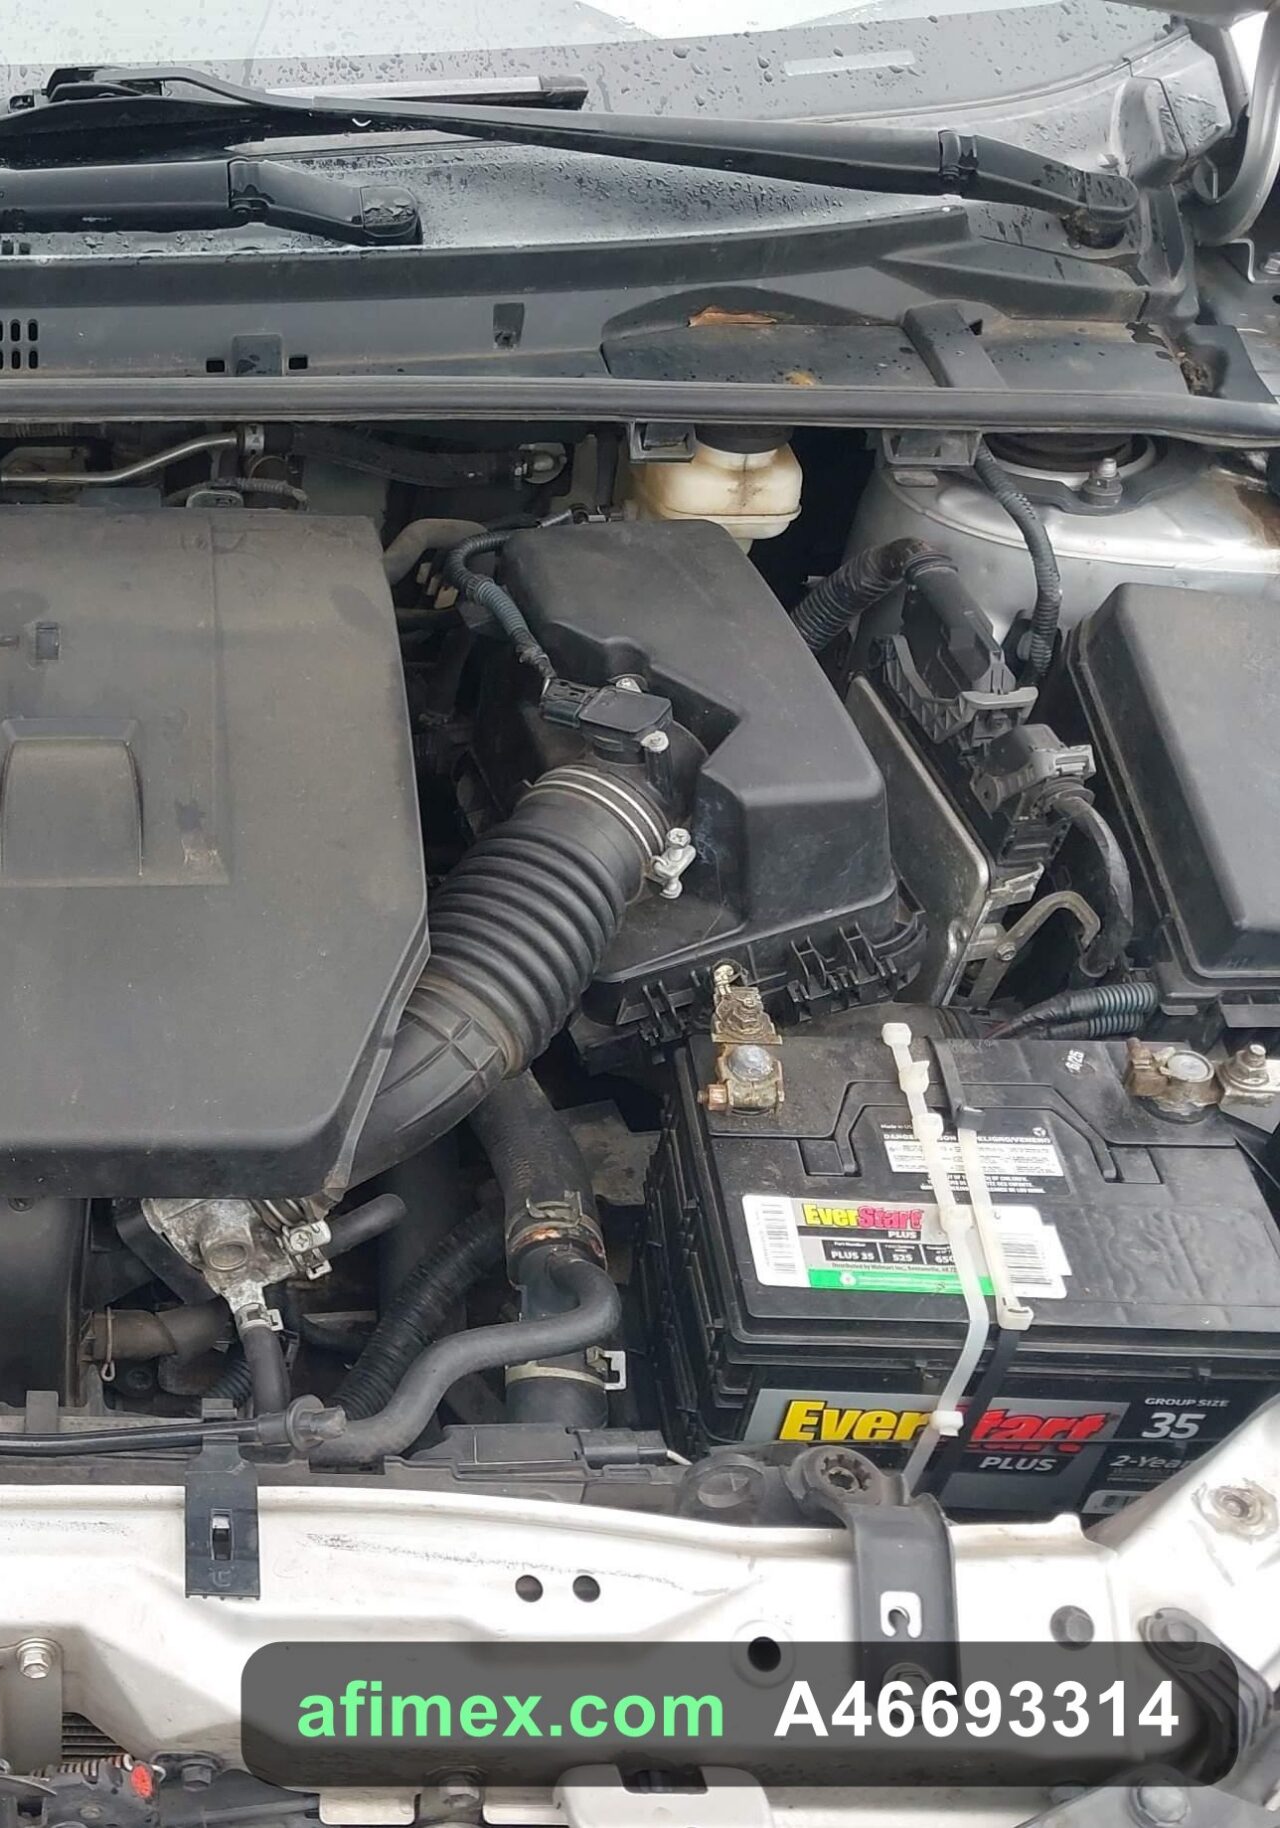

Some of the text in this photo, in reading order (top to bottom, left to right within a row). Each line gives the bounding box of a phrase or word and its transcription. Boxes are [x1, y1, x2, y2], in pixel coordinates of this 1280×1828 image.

[801, 1203, 924, 1230] EverStart
[887, 1231, 918, 1240] PLUS
[831, 1250, 875, 1261] PLUS 35
[892, 1253, 914, 1262] 525
[1144, 1397, 1230, 1408] GROUP SIZE
[1141, 1412, 1206, 1439] 35
[978, 1456, 1057, 1472] PLUS
